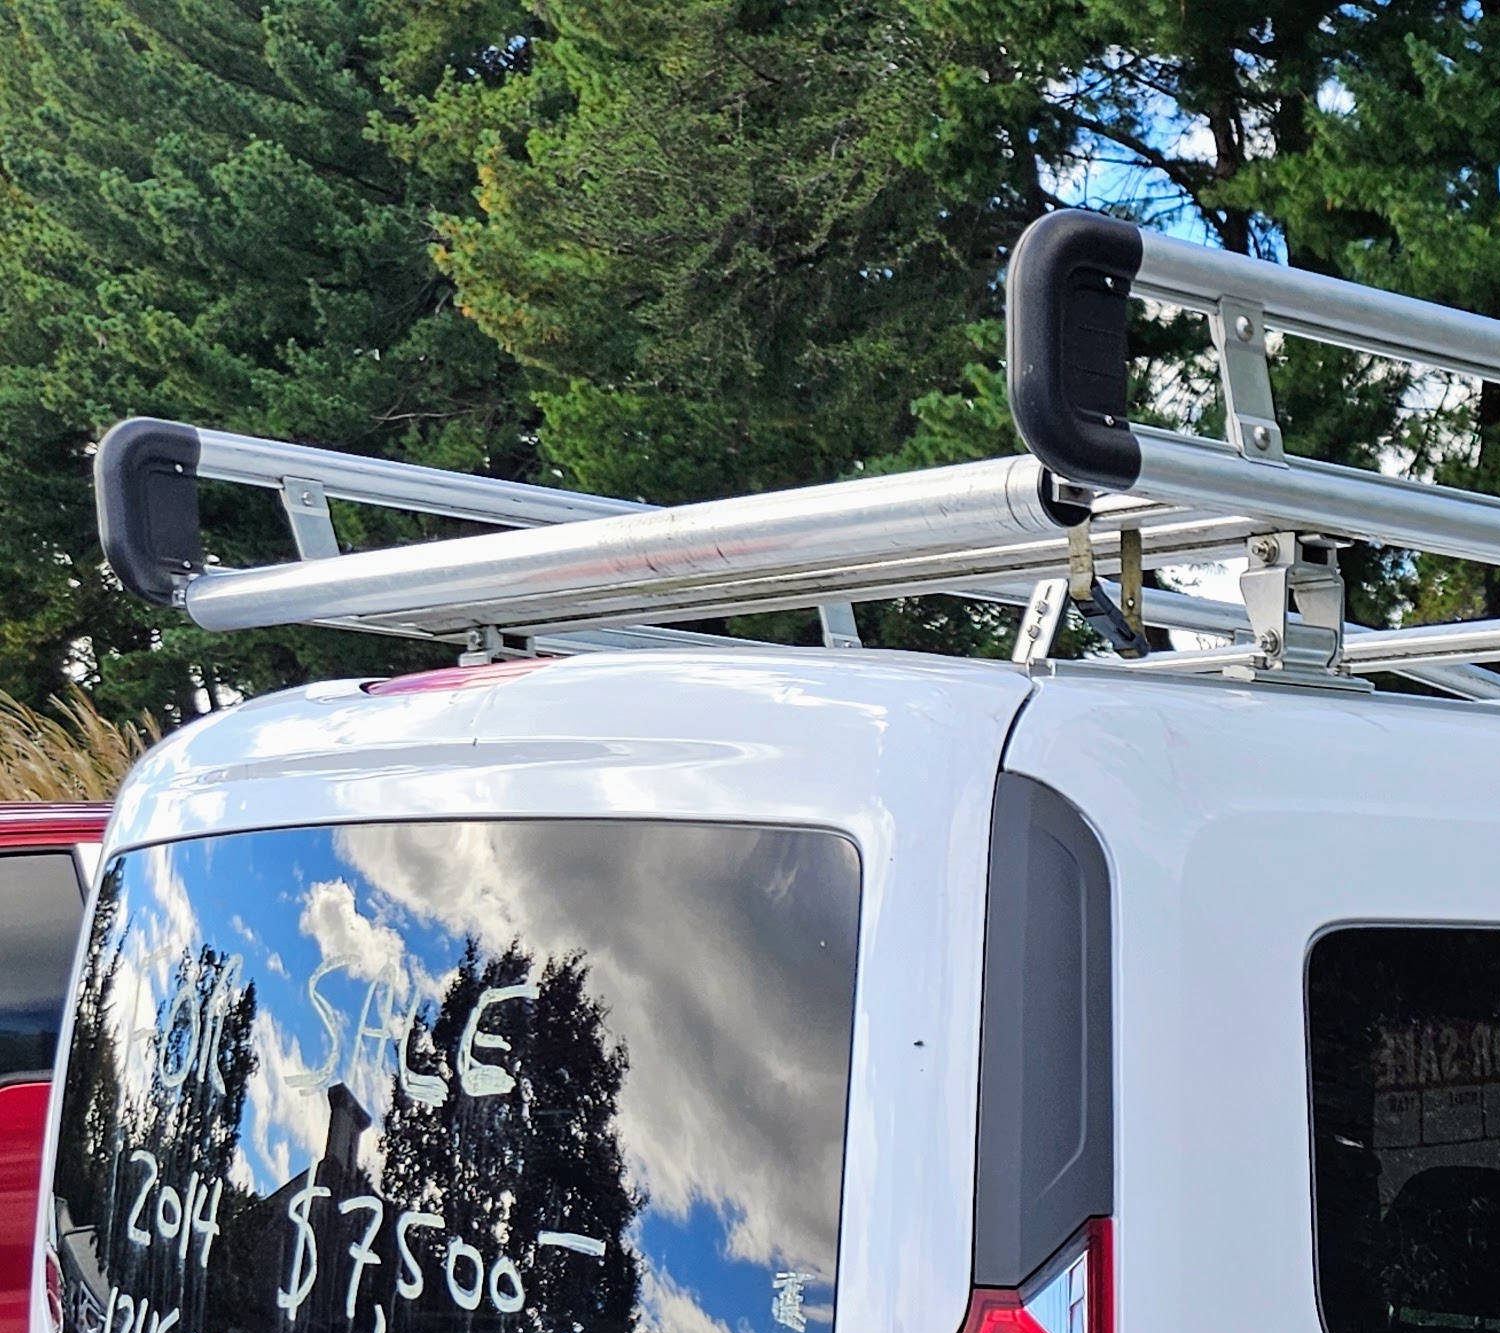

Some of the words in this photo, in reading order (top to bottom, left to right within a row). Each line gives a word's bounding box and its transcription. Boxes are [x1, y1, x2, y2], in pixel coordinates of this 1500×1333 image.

[126, 944, 245, 1096] FOR
[284, 954, 541, 1107] SALE
[127, 1150, 223, 1268] 2014
